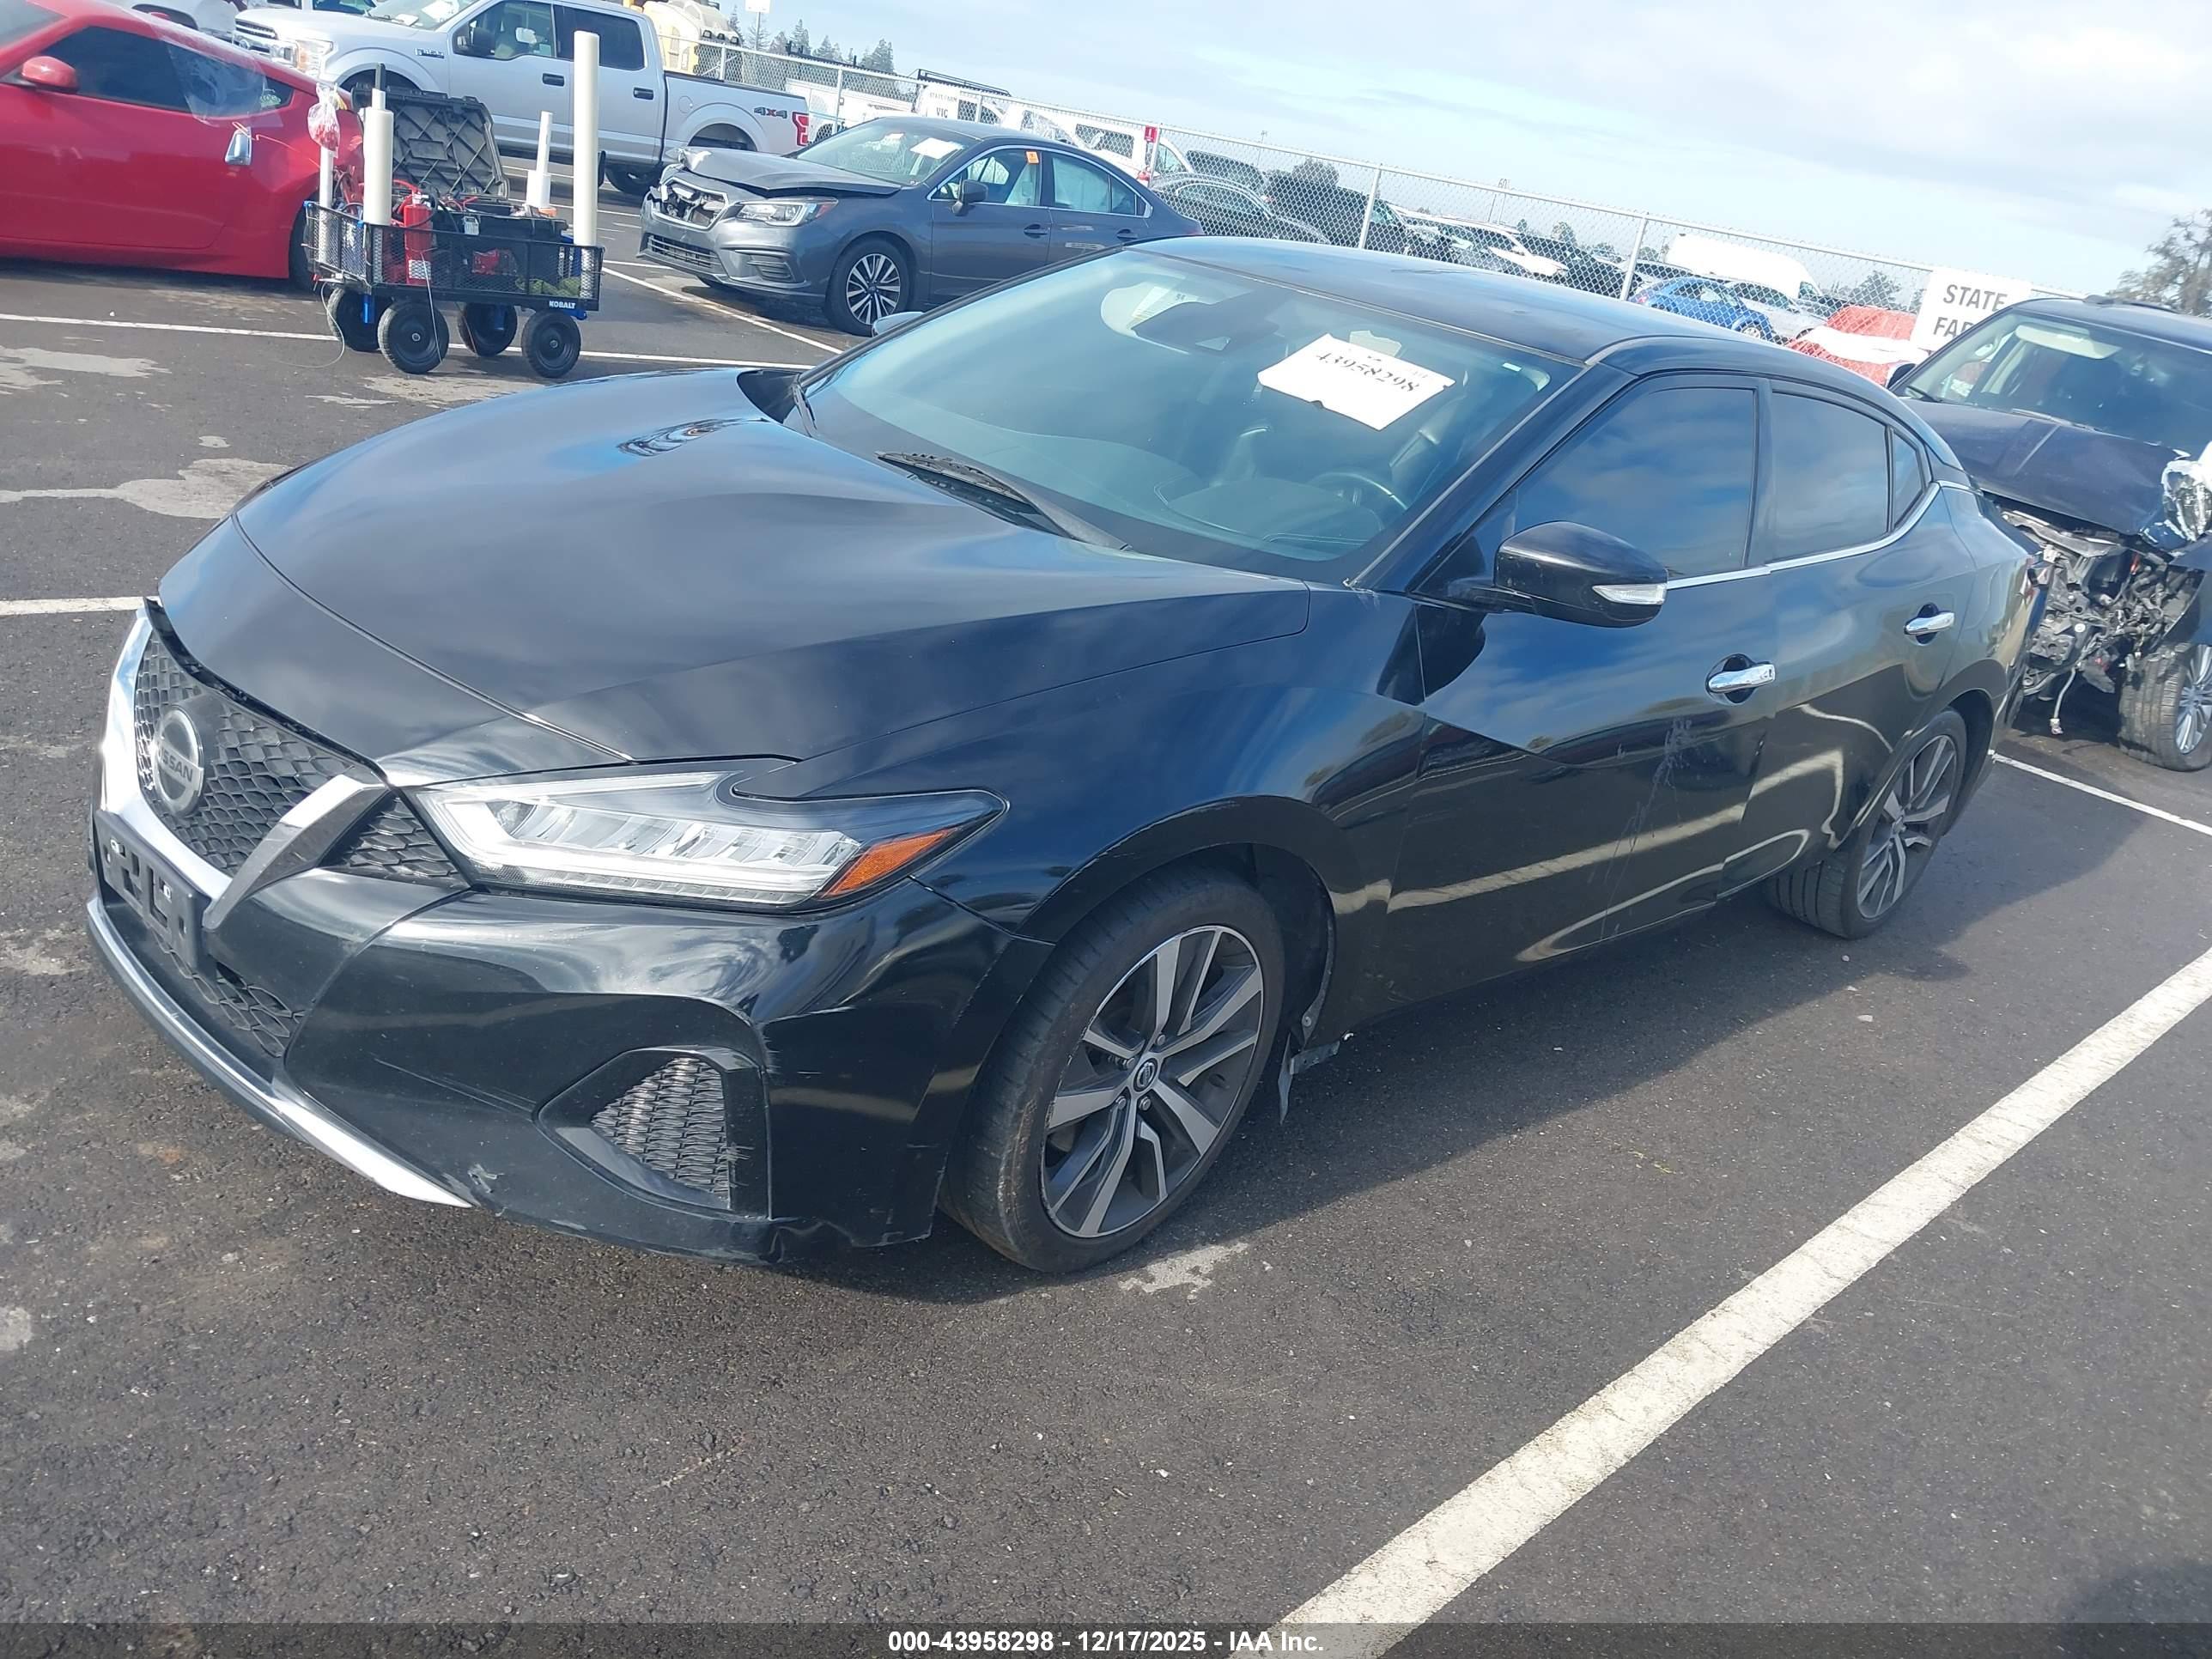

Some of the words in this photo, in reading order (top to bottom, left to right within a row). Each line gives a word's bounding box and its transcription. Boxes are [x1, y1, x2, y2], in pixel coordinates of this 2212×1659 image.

[936, 106, 949, 118] VIC
[1943, 284, 2008, 312] STATE
[549, 301, 576, 309] KOBALT
